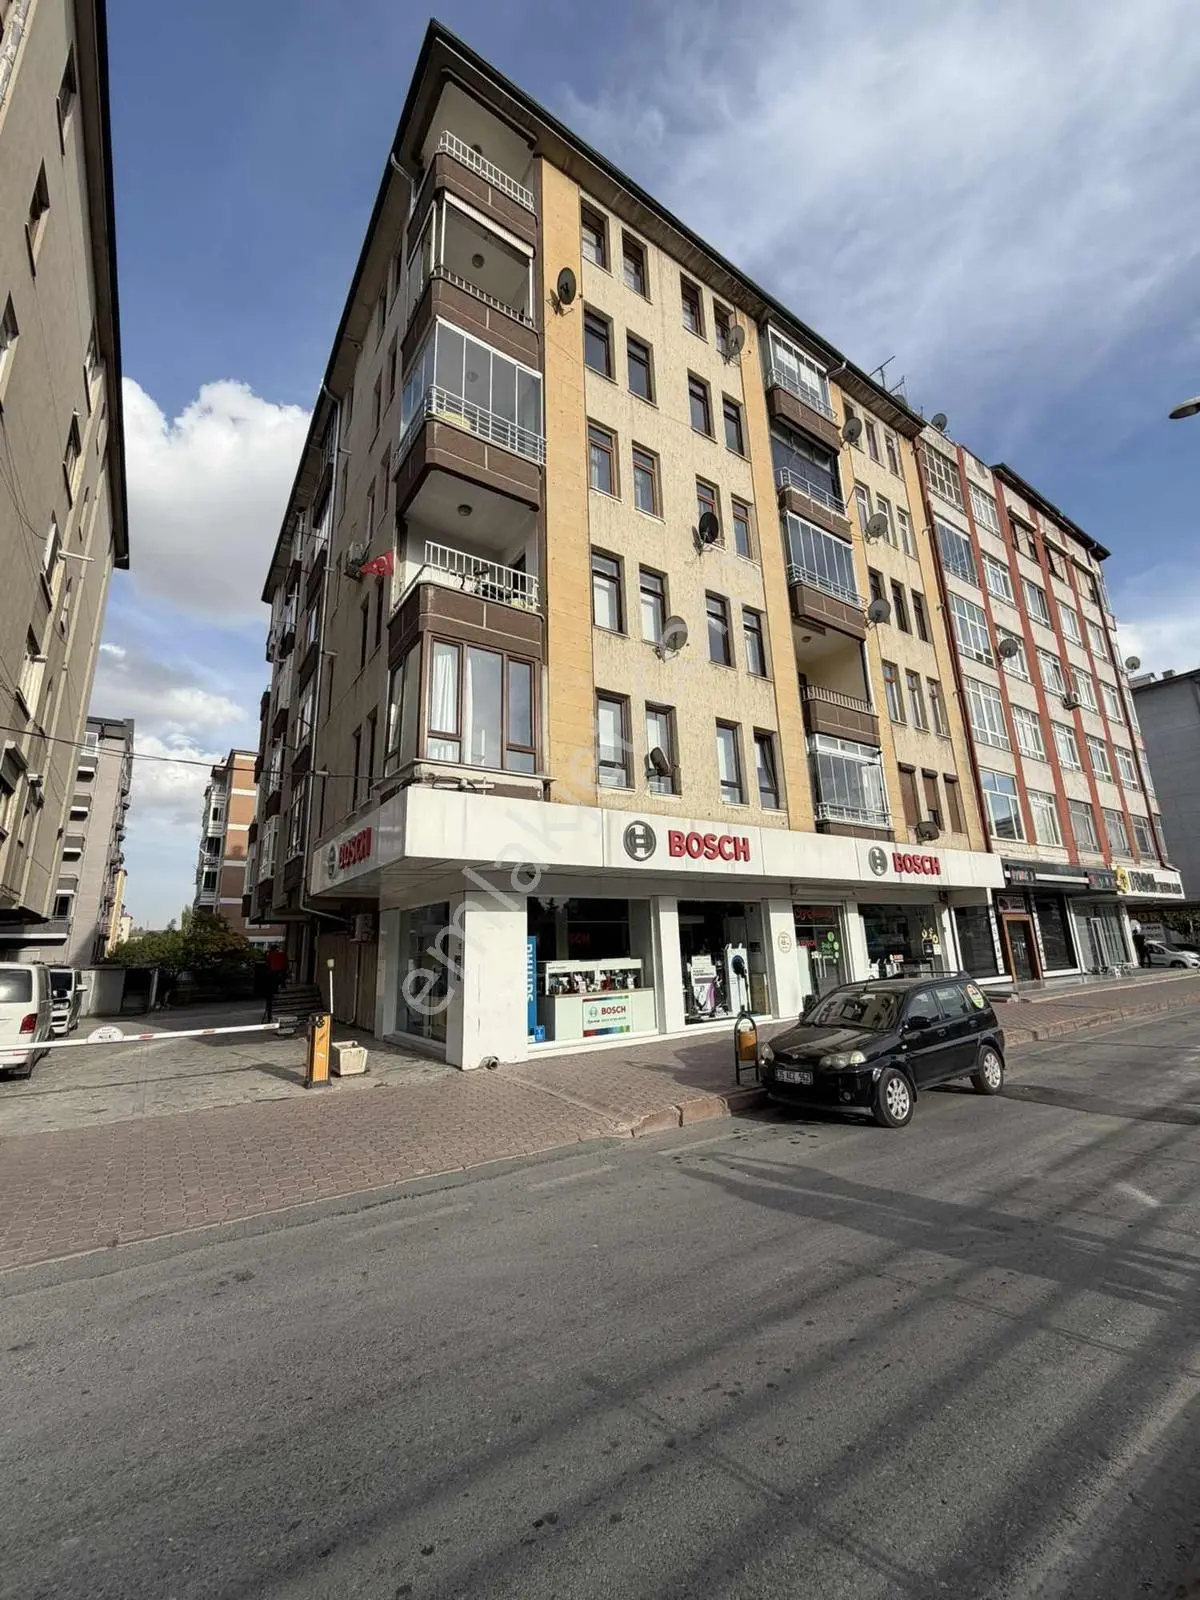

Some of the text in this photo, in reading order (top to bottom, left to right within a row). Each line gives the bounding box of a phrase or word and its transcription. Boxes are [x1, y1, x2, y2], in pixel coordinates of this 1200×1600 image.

[339, 827, 372, 870] BOSCH
[668, 830, 751, 862] BOSCH
[892, 852, 942, 876] BOSCH
[601, 1005, 626, 1015] BOSCH
